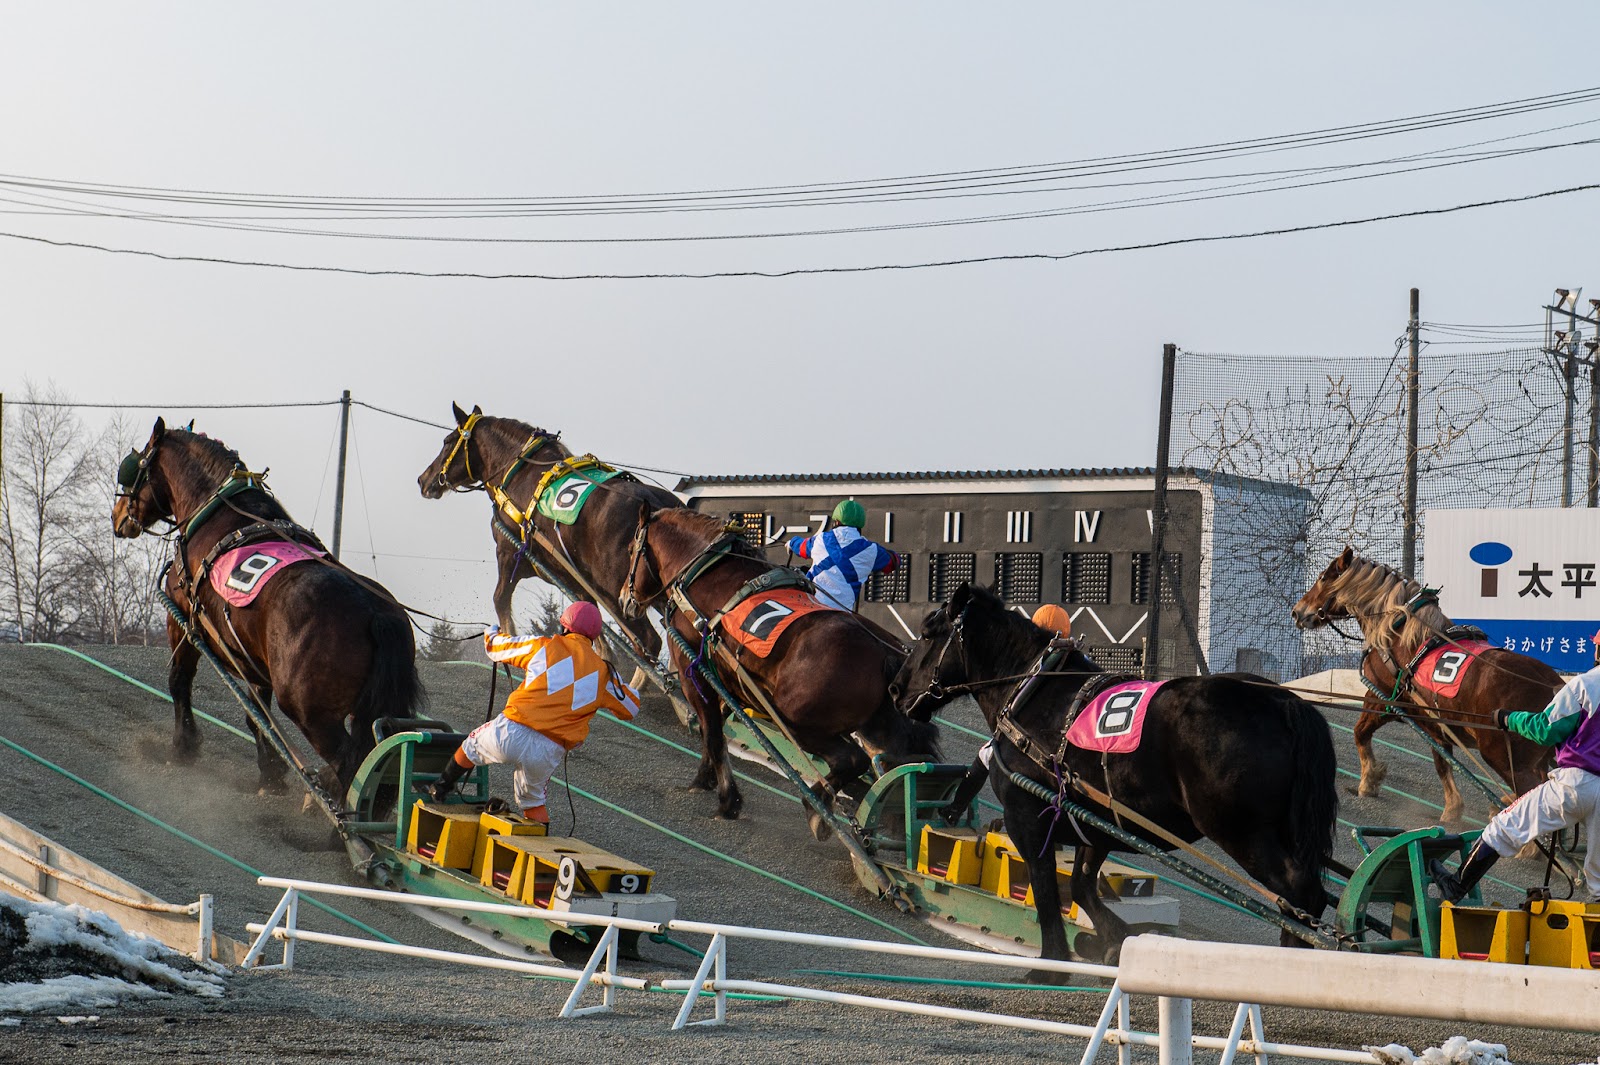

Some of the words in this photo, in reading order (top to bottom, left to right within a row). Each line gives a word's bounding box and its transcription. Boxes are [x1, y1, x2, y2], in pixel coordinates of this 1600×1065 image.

[555, 482, 589, 509] 6
[943, 511, 960, 543] II
[1006, 511, 1030, 543] III
[1074, 510, 1101, 543] IV
[225, 553, 278, 593] 9
[1517, 562, 1597, 599] 太平
[749, 599, 795, 634] 7
[1433, 651, 1467, 683] 3
[1097, 691, 1143, 735] 8
[556, 856, 576, 901] 9
[620, 874, 640, 894] 9
[1131, 879, 1147, 896] 7
